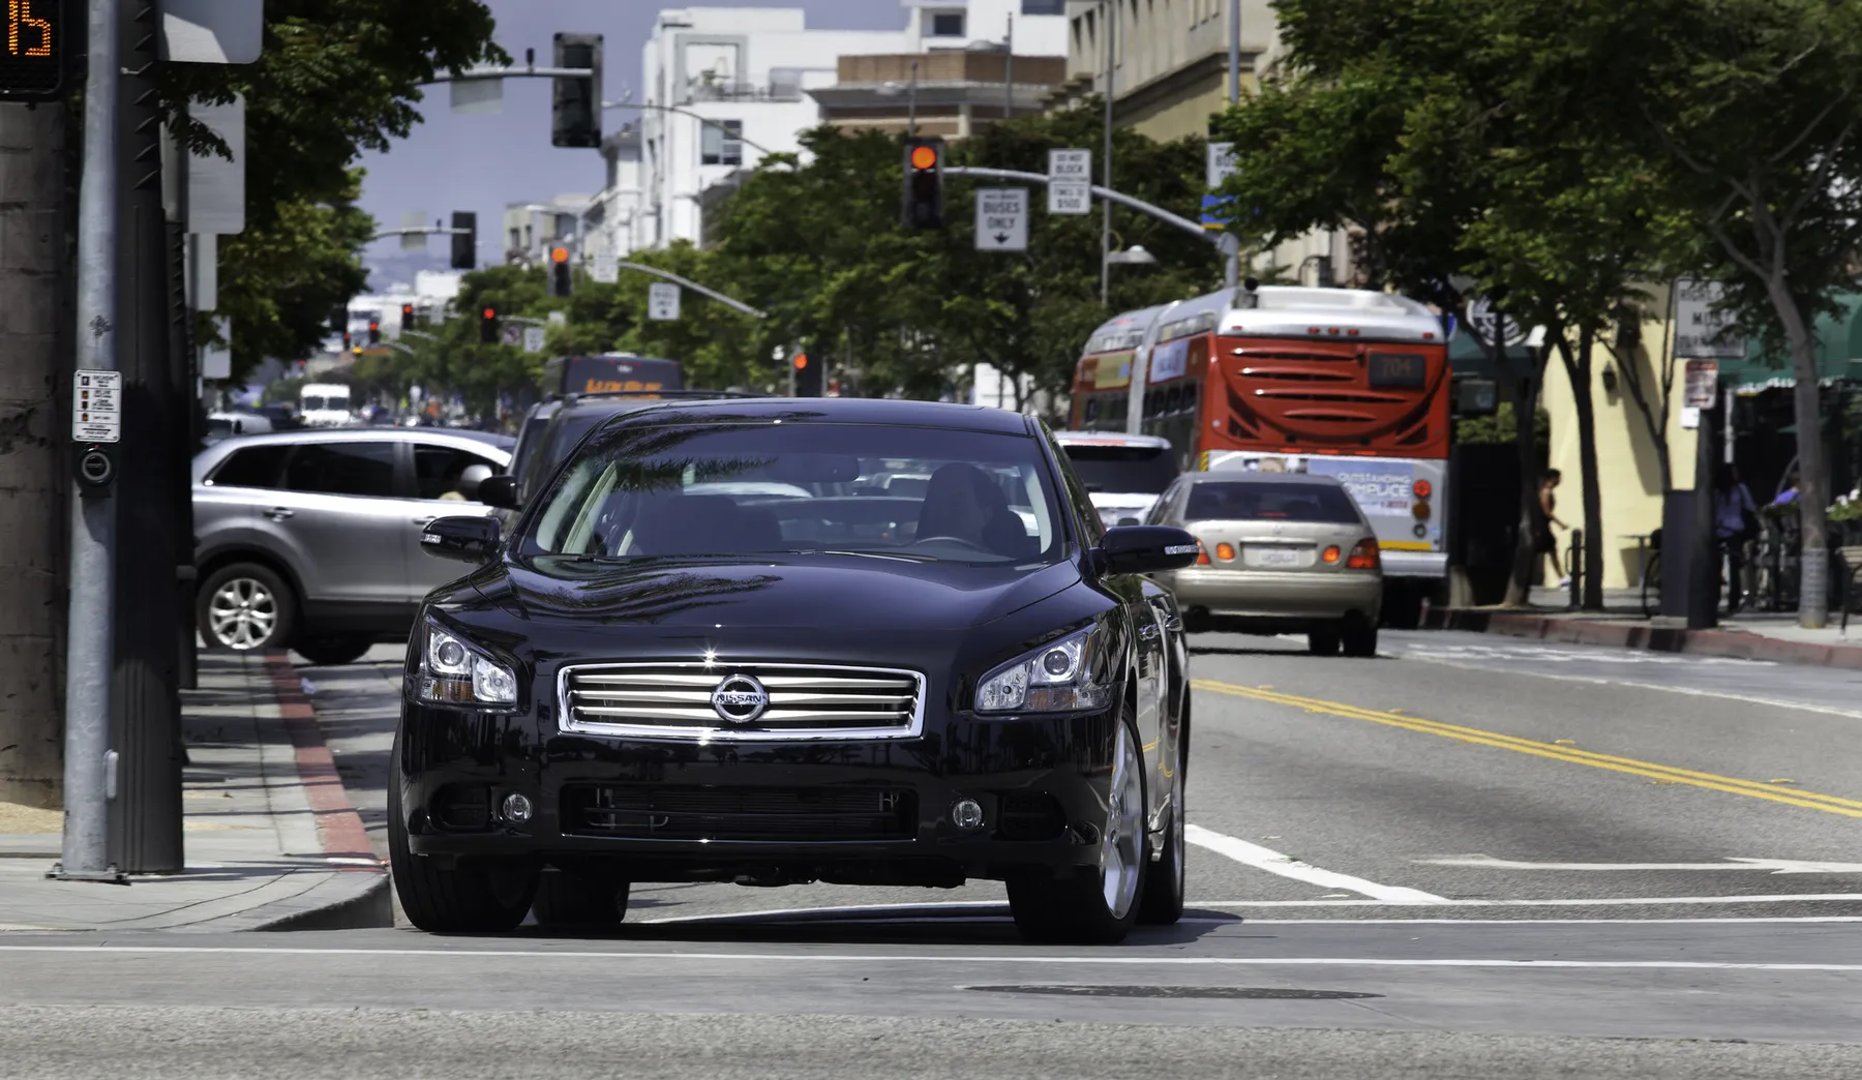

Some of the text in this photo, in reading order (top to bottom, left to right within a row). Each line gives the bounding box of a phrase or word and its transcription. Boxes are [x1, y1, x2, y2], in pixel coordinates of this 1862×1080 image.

[1056, 164, 1083, 174] BLOCK
[983, 201, 1020, 214] BUSES
[987, 216, 1015, 229] ONLY
[1692, 311, 1734, 327] MUST
[1343, 481, 1410, 497] OMPLICE
[716, 694, 762, 702] NISSAN
